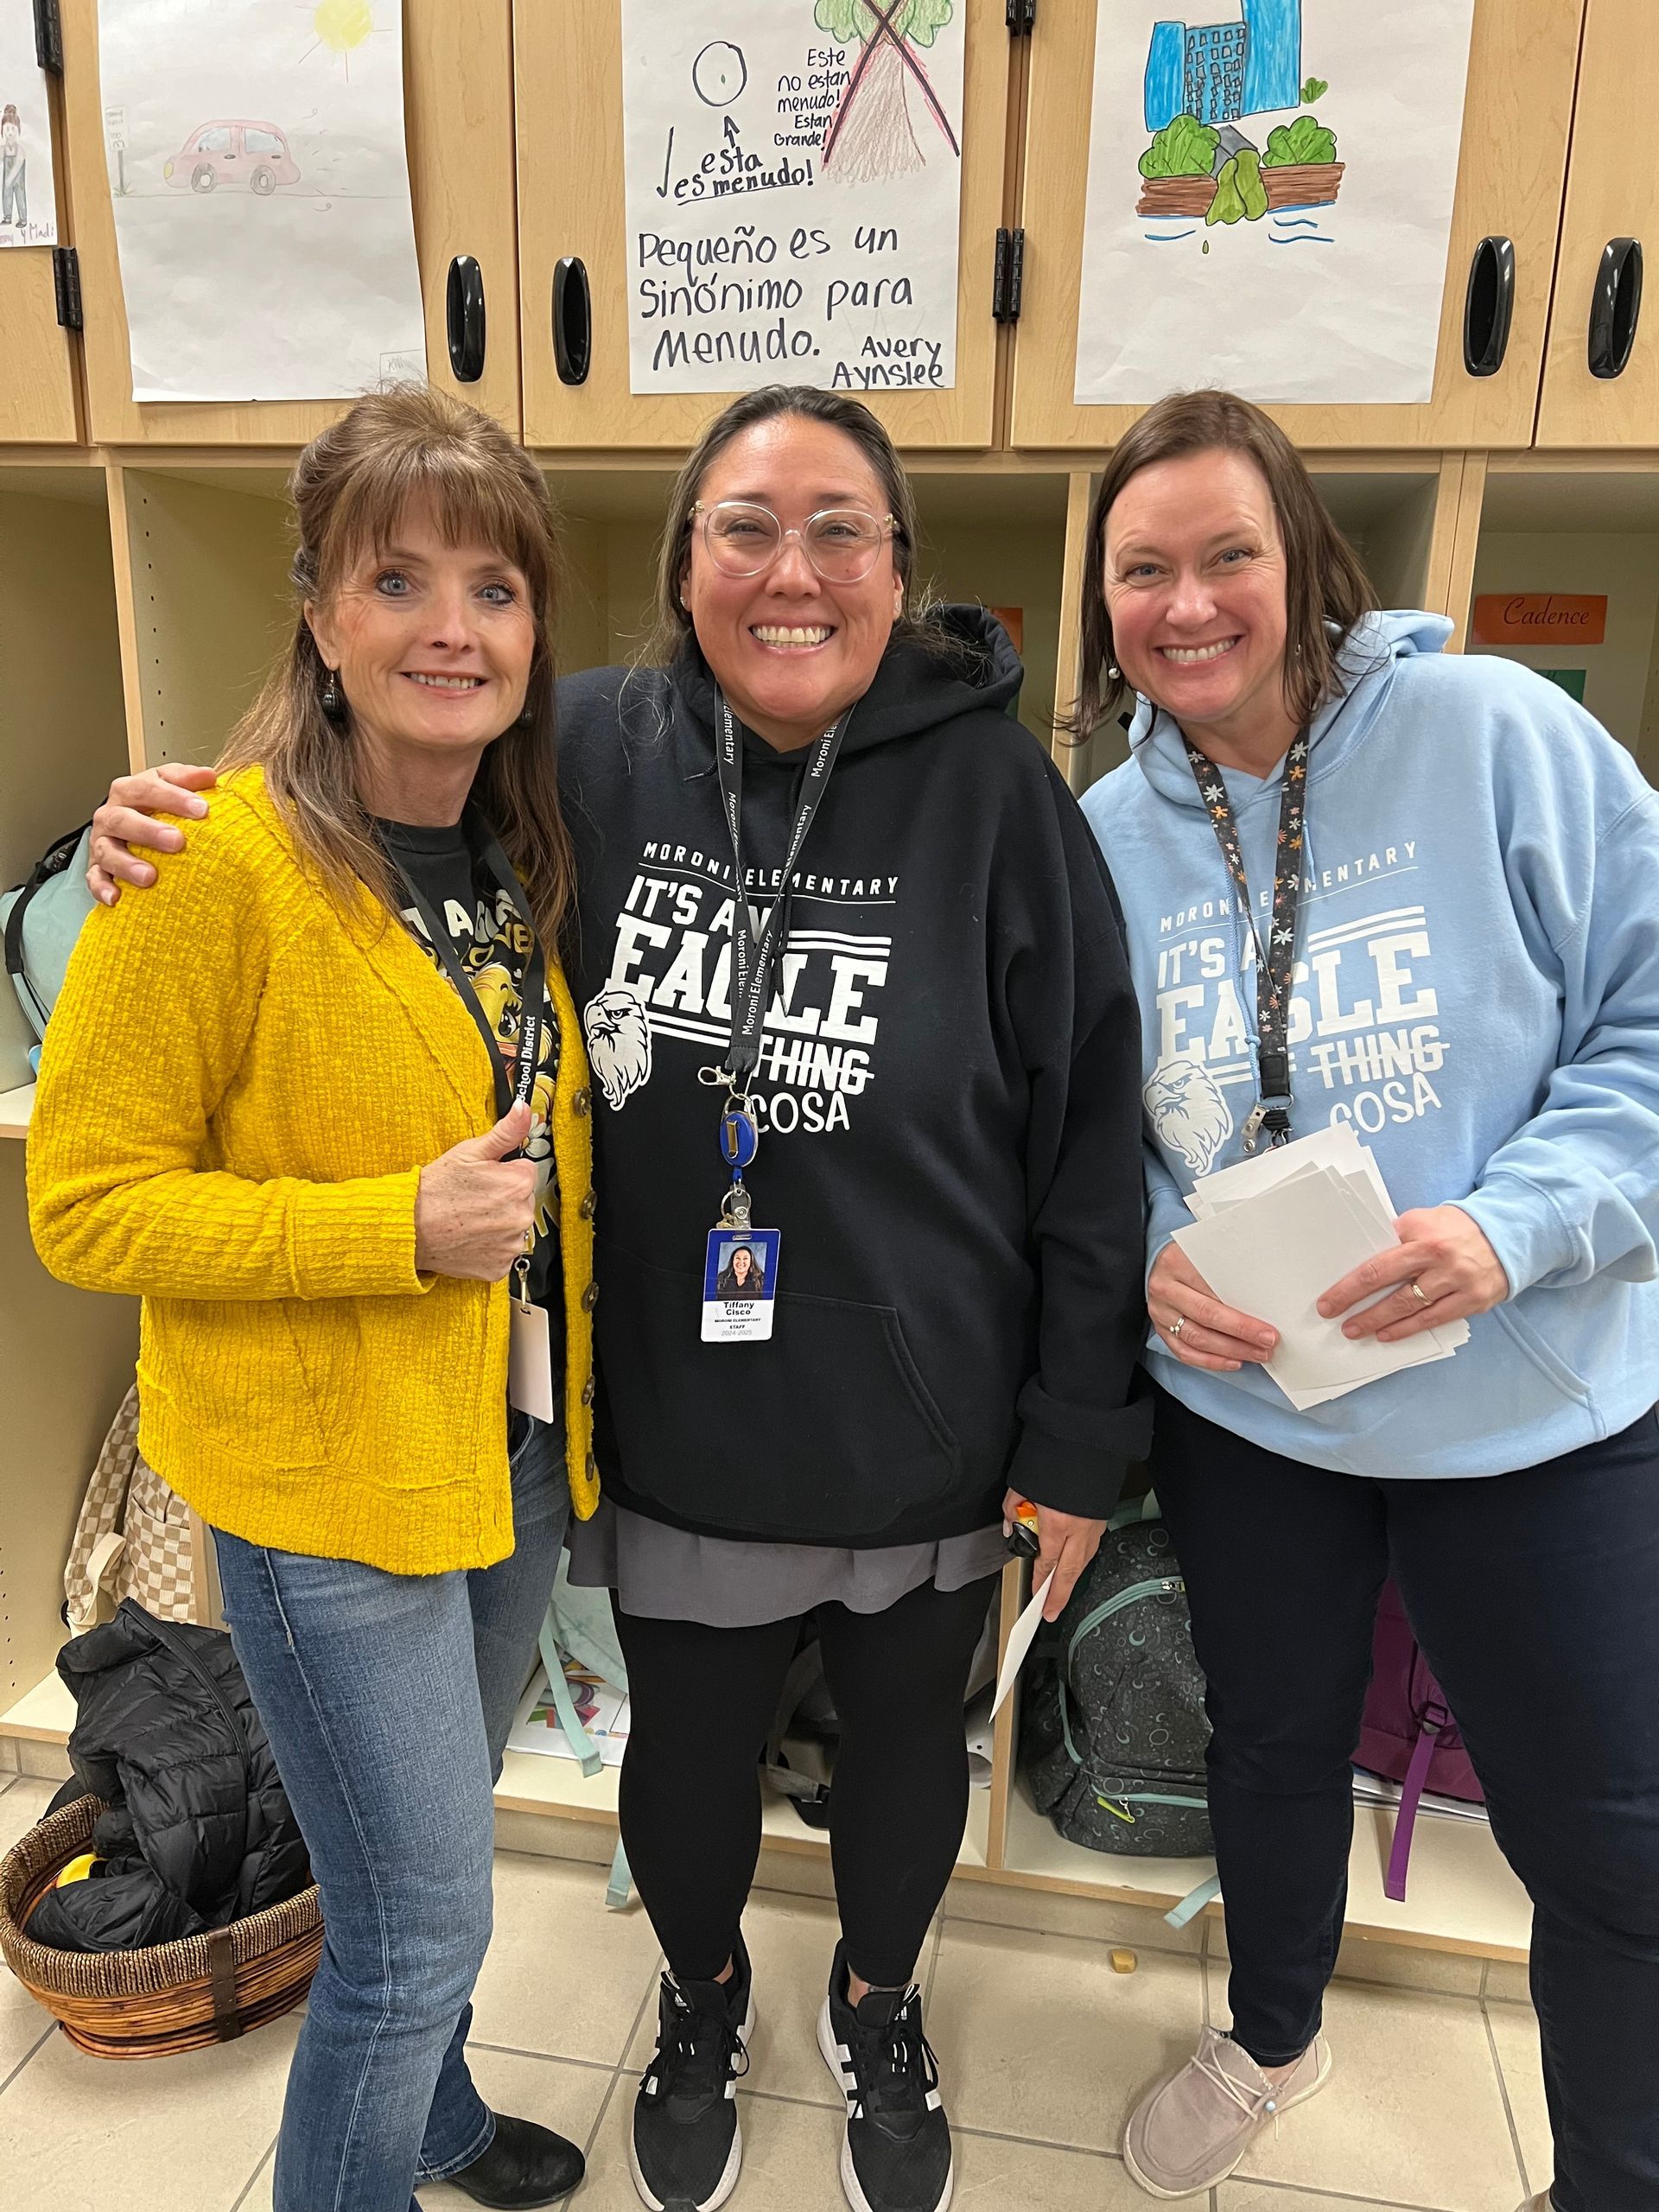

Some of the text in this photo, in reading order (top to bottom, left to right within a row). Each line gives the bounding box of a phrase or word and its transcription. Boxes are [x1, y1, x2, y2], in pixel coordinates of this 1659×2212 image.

[807, 47, 845, 67] Este
[778, 69, 851, 92] no estan
[778, 88, 841, 112] menudo!
[773, 129, 828, 151] Grande!
[794, 112, 833, 129] Estan
[674, 156, 814, 199] es menudo!
[701, 146, 763, 175] esta
[639, 226, 898, 286] Pequeño es un
[639, 272, 912, 321] Sinónimo para
[652, 318, 821, 371] Menudo.
[861, 335, 942, 372] Avery
[831, 357, 945, 389] Aynslee
[1503, 595, 1590, 626] Cadence
[810, 739, 832, 779] Moroni
[643, 842, 731, 880] MORONI
[624, 875, 703, 926] IT'S
[737, 929, 749, 971] Moroni
[750, 929, 772, 995] Elementary
[1157, 937, 1226, 989] IT'S
[741, 994, 760, 1036] Moroni
[520, 1015, 536, 1060] District
[1310, 1025, 1446, 1089] THING
[747, 1090, 850, 1135] COSA
[1329, 1071, 1442, 1134] COSA
